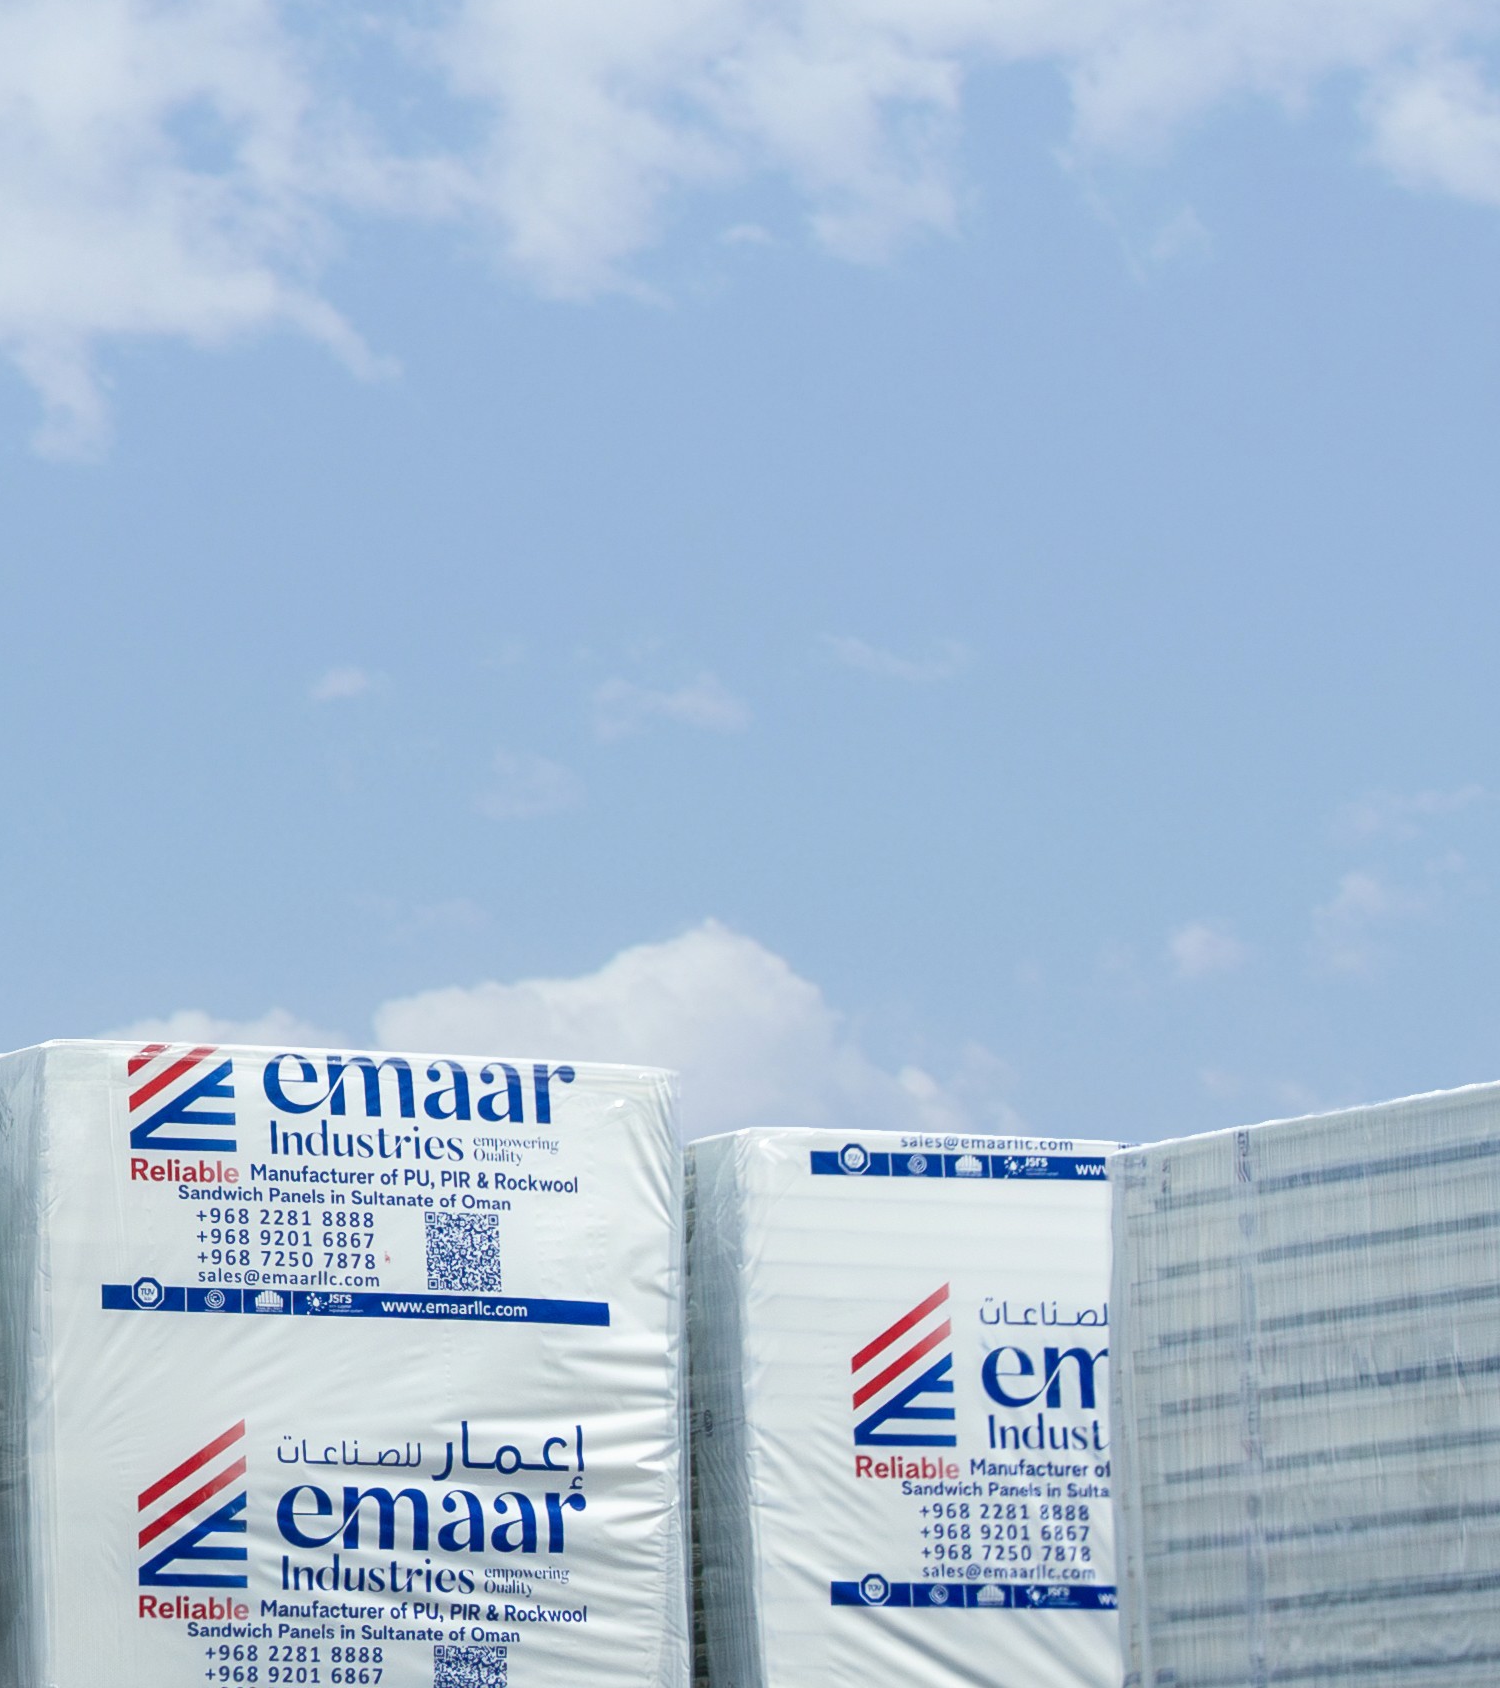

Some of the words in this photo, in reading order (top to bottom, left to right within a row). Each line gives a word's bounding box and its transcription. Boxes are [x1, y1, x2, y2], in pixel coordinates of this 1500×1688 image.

[263, 1054, 575, 1124] emaar
[270, 1119, 464, 1161] Industries
[473, 1137, 559, 1154] empowering
[473, 1148, 521, 1166] Quality
[131, 1158, 238, 1183] Reliable
[251, 1163, 375, 1184] Manufacturer
[380, 1168, 398, 1186] of
[404, 1169, 435, 1189] PU,
[441, 1170, 470, 1188] PIR
[477, 1172, 489, 1189] &
[494, 1172, 578, 1193] Rockwool
[198, 1267, 380, 1287] sales@emaarllc.com
[381, 1301, 528, 1317] www.emaarllc.com
[980, 1296, 1109, 1326] لصناعات
[988, 1412, 1112, 1450] Indust
[277, 1436, 422, 1468] للصناعات
[431, 1420, 585, 1490] إعمار
[855, 1455, 958, 1479] Reliable
[970, 1458, 1088, 1478] Manufacturer
[902, 1480, 983, 1496] Sandwich
[988, 1482, 1042, 1497] Panels
[1047, 1483, 1061, 1498] in
[1067, 1482, 1111, 1498] Sulta
[276, 1485, 586, 1554] emaar
[282, 1553, 475, 1594] Industries
[139, 1595, 249, 1620] Reliable
[260, 1599, 385, 1620] Manufacturer
[389, 1601, 408, 1621] of
[413, 1598, 446, 1623] PU,
[450, 1603, 481, 1621] PIR
[485, 1604, 500, 1622] &
[504, 1604, 588, 1623] Rockwool
